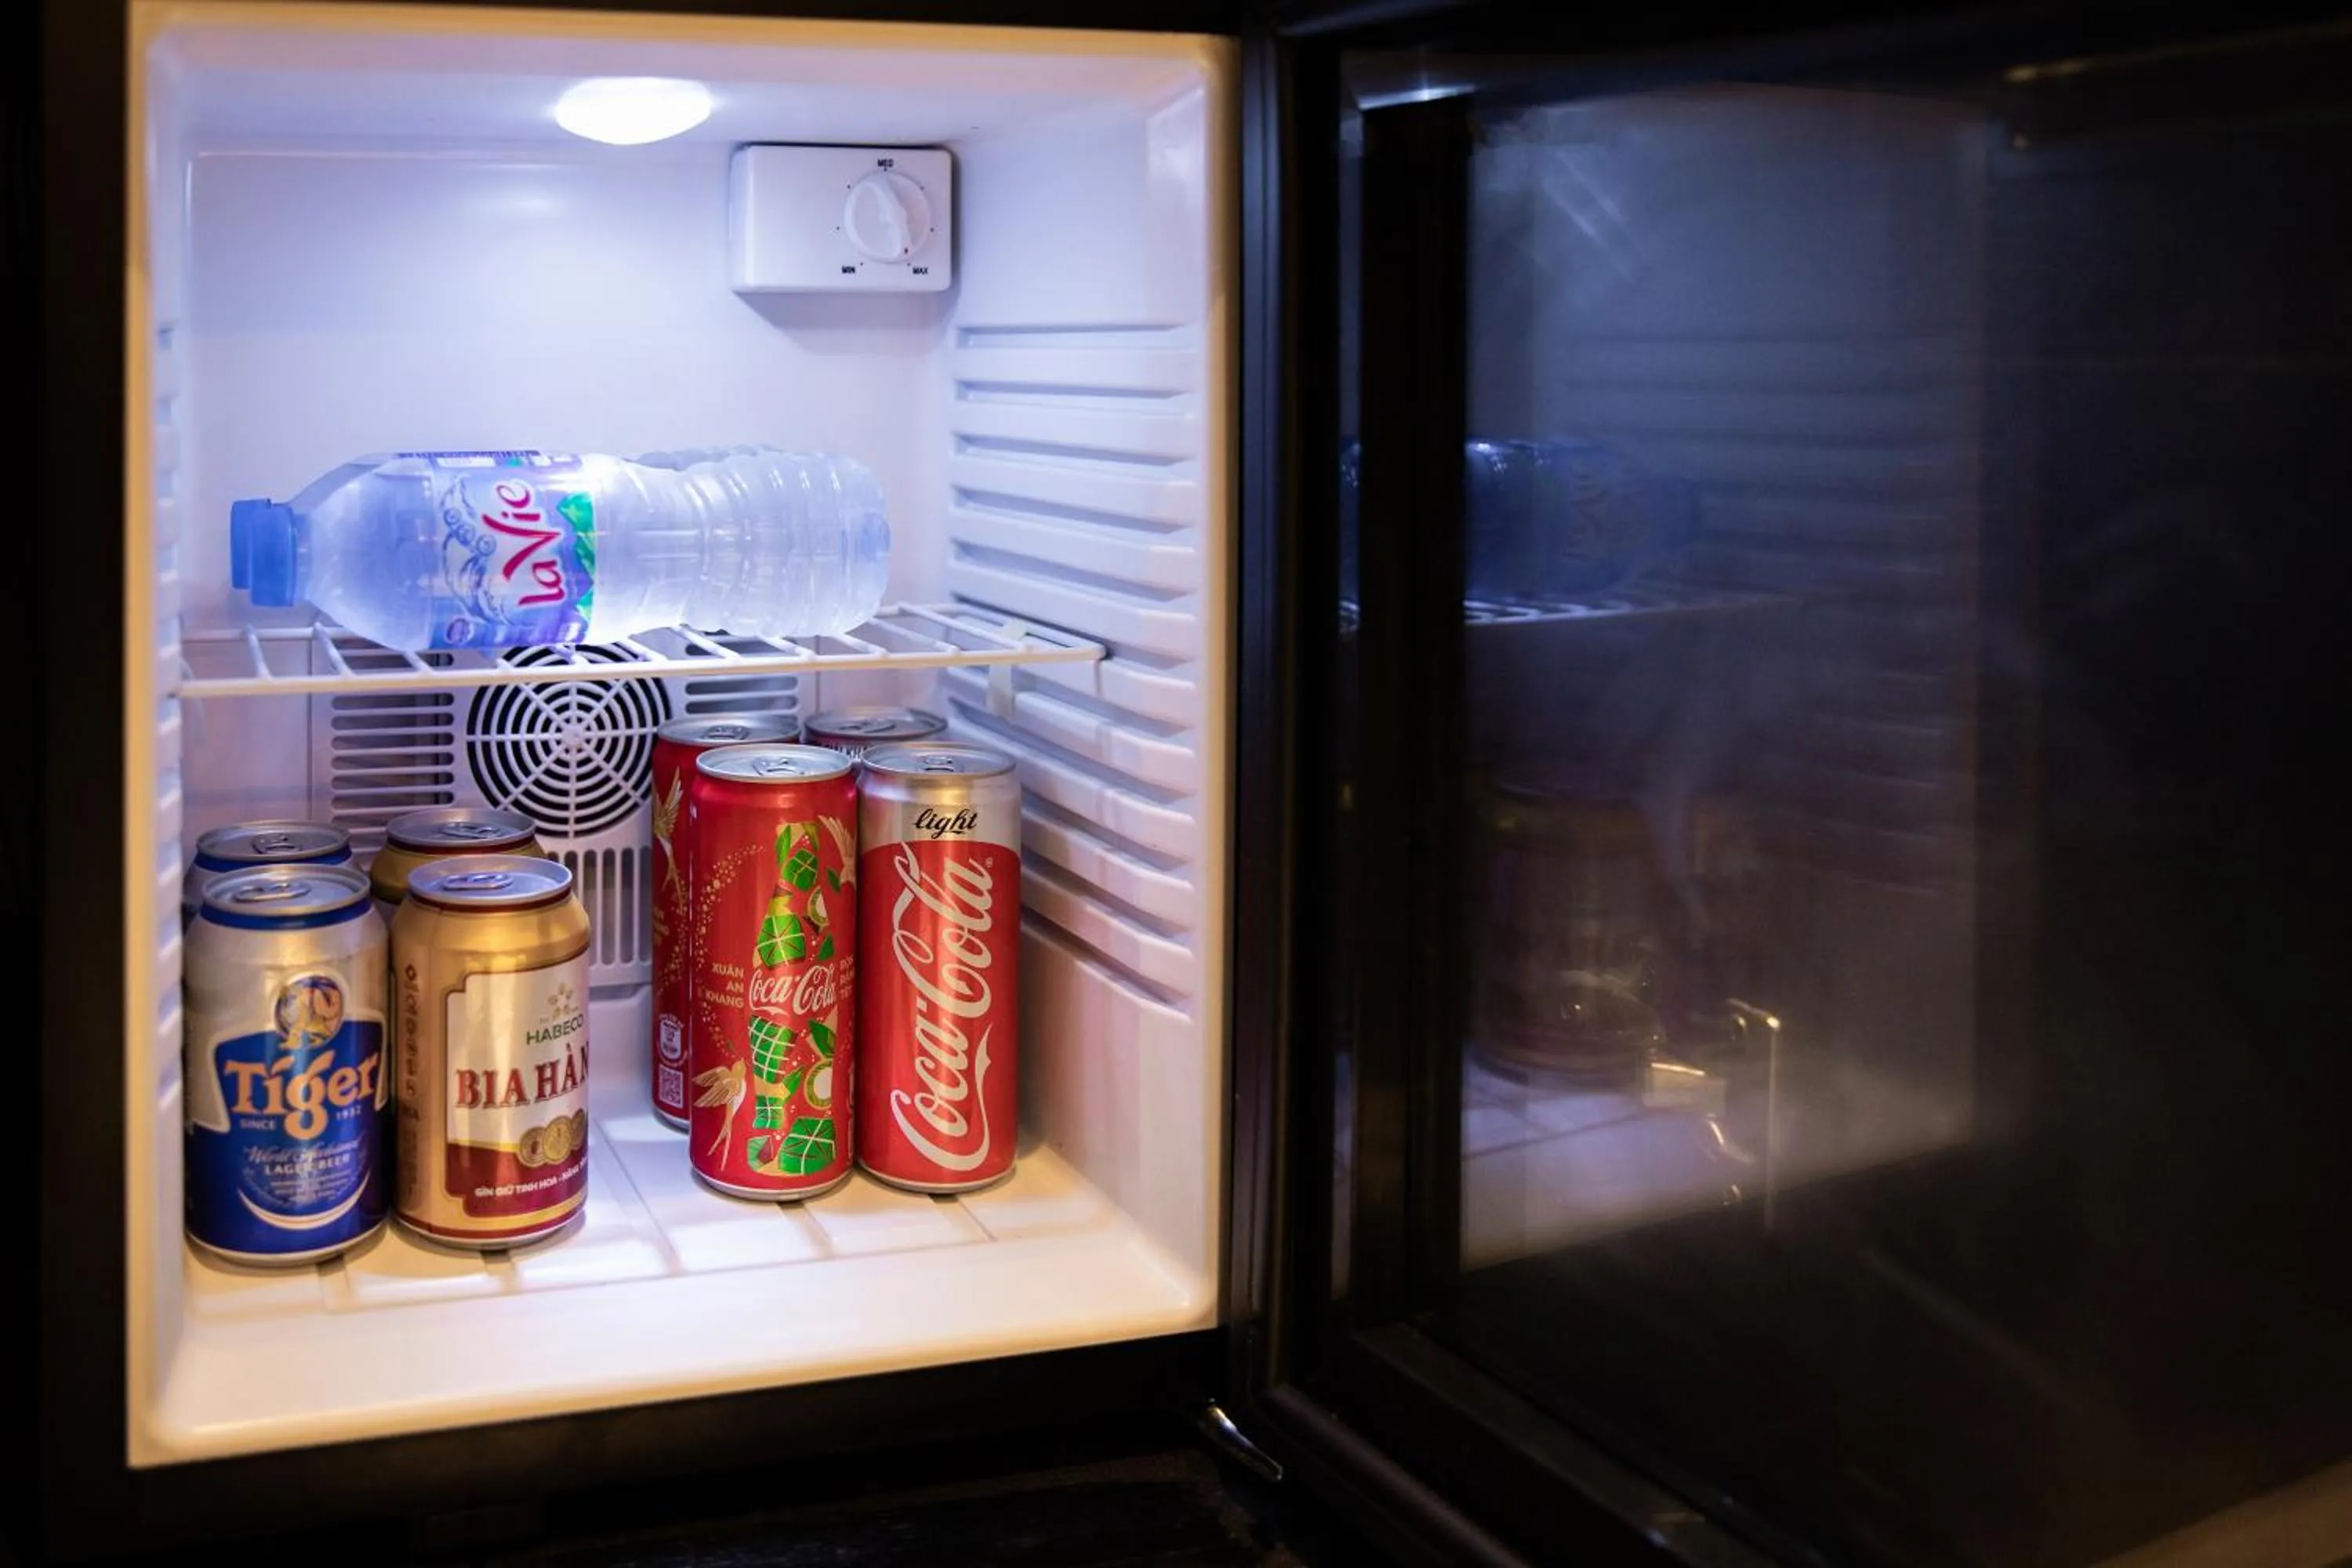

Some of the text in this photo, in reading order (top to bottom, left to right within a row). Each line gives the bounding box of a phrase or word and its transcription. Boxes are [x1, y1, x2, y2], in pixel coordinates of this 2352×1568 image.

[877, 158, 894, 168] MED
[841, 266, 856, 274] MIN
[913, 267, 929, 275] MAX
[913, 808, 978, 840] light
[726, 981, 744, 994] AN
[526, 1014, 583, 1046] HABECO
[456, 1067, 530, 1109] BIA
[224, 1050, 379, 1140] Tiger
[240, 1118, 276, 1130] SINCE
[264, 1163, 313, 1176] LAGER
